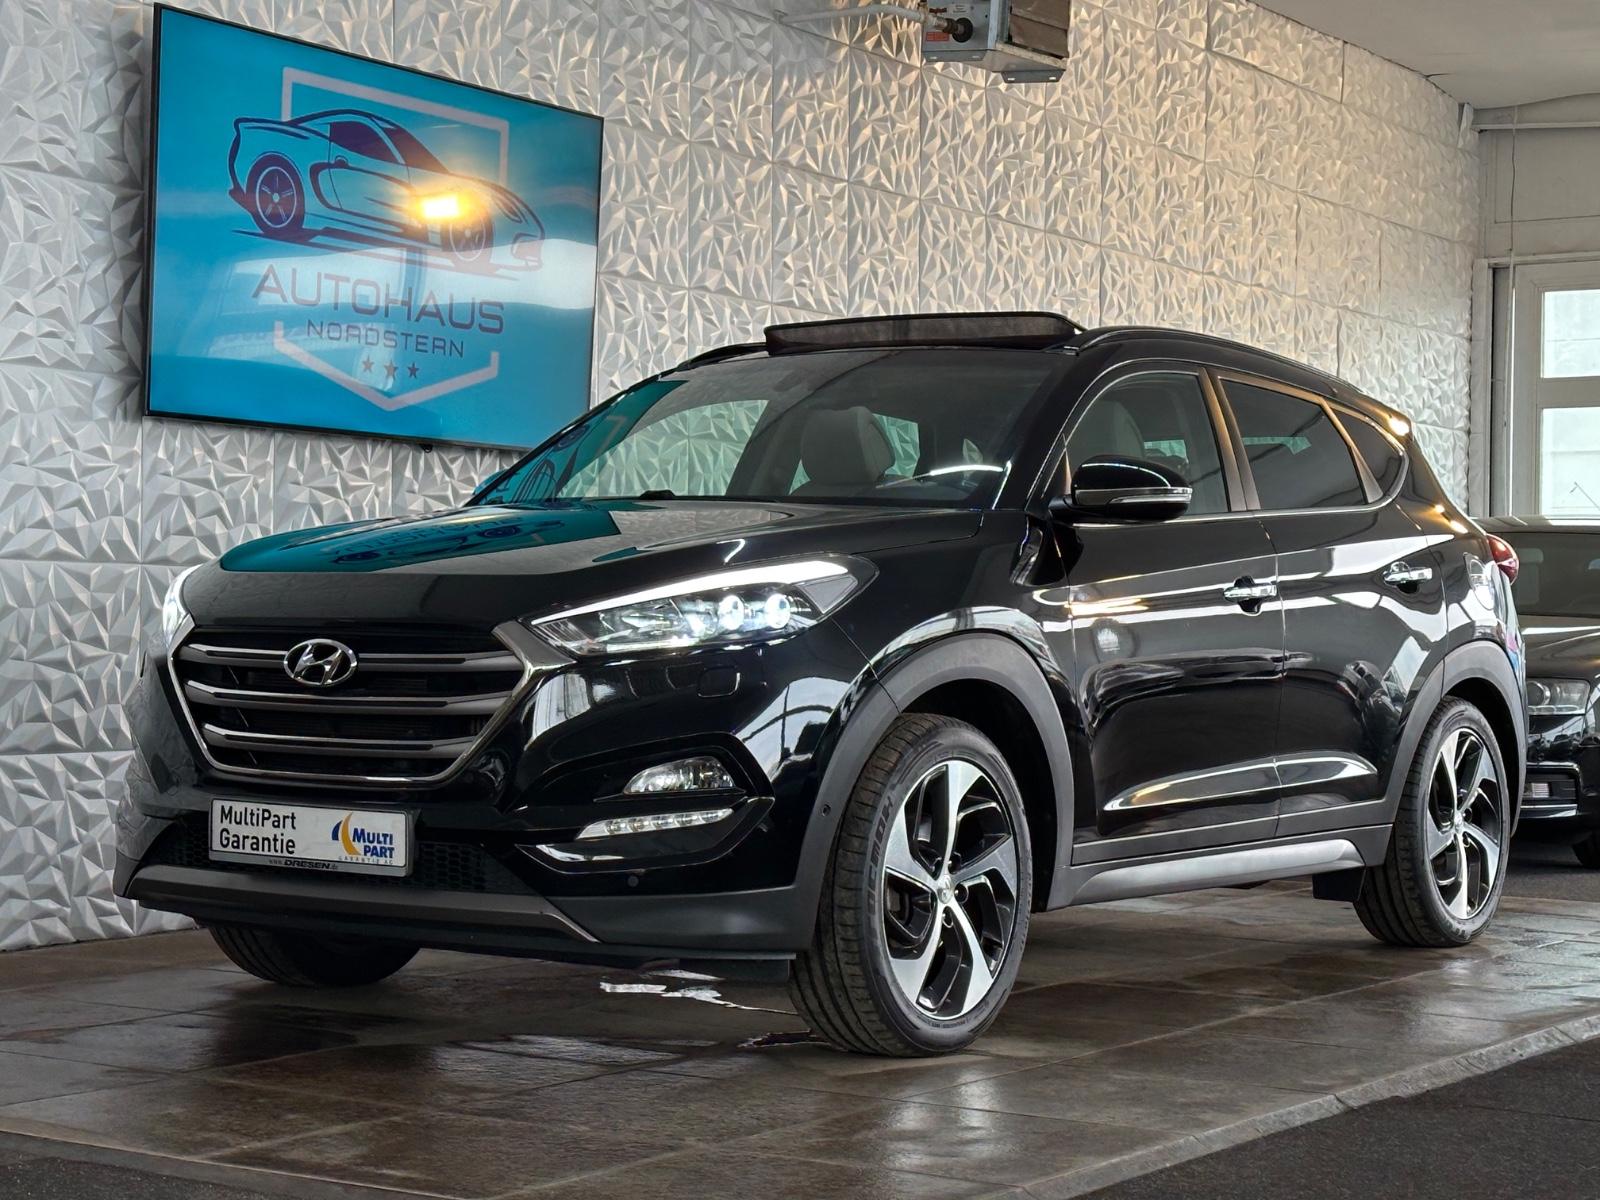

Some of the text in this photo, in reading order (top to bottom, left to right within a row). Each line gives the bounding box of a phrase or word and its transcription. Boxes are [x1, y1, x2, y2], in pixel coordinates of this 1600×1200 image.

[252, 263, 505, 335] AUTOHAUS
[307, 319, 464, 358] NORDSTERN
[220, 804, 297, 830] MultiPart
[219, 828, 296, 855] Garantie
[352, 827, 394, 844] MULTI
[363, 845, 395, 859] PART
